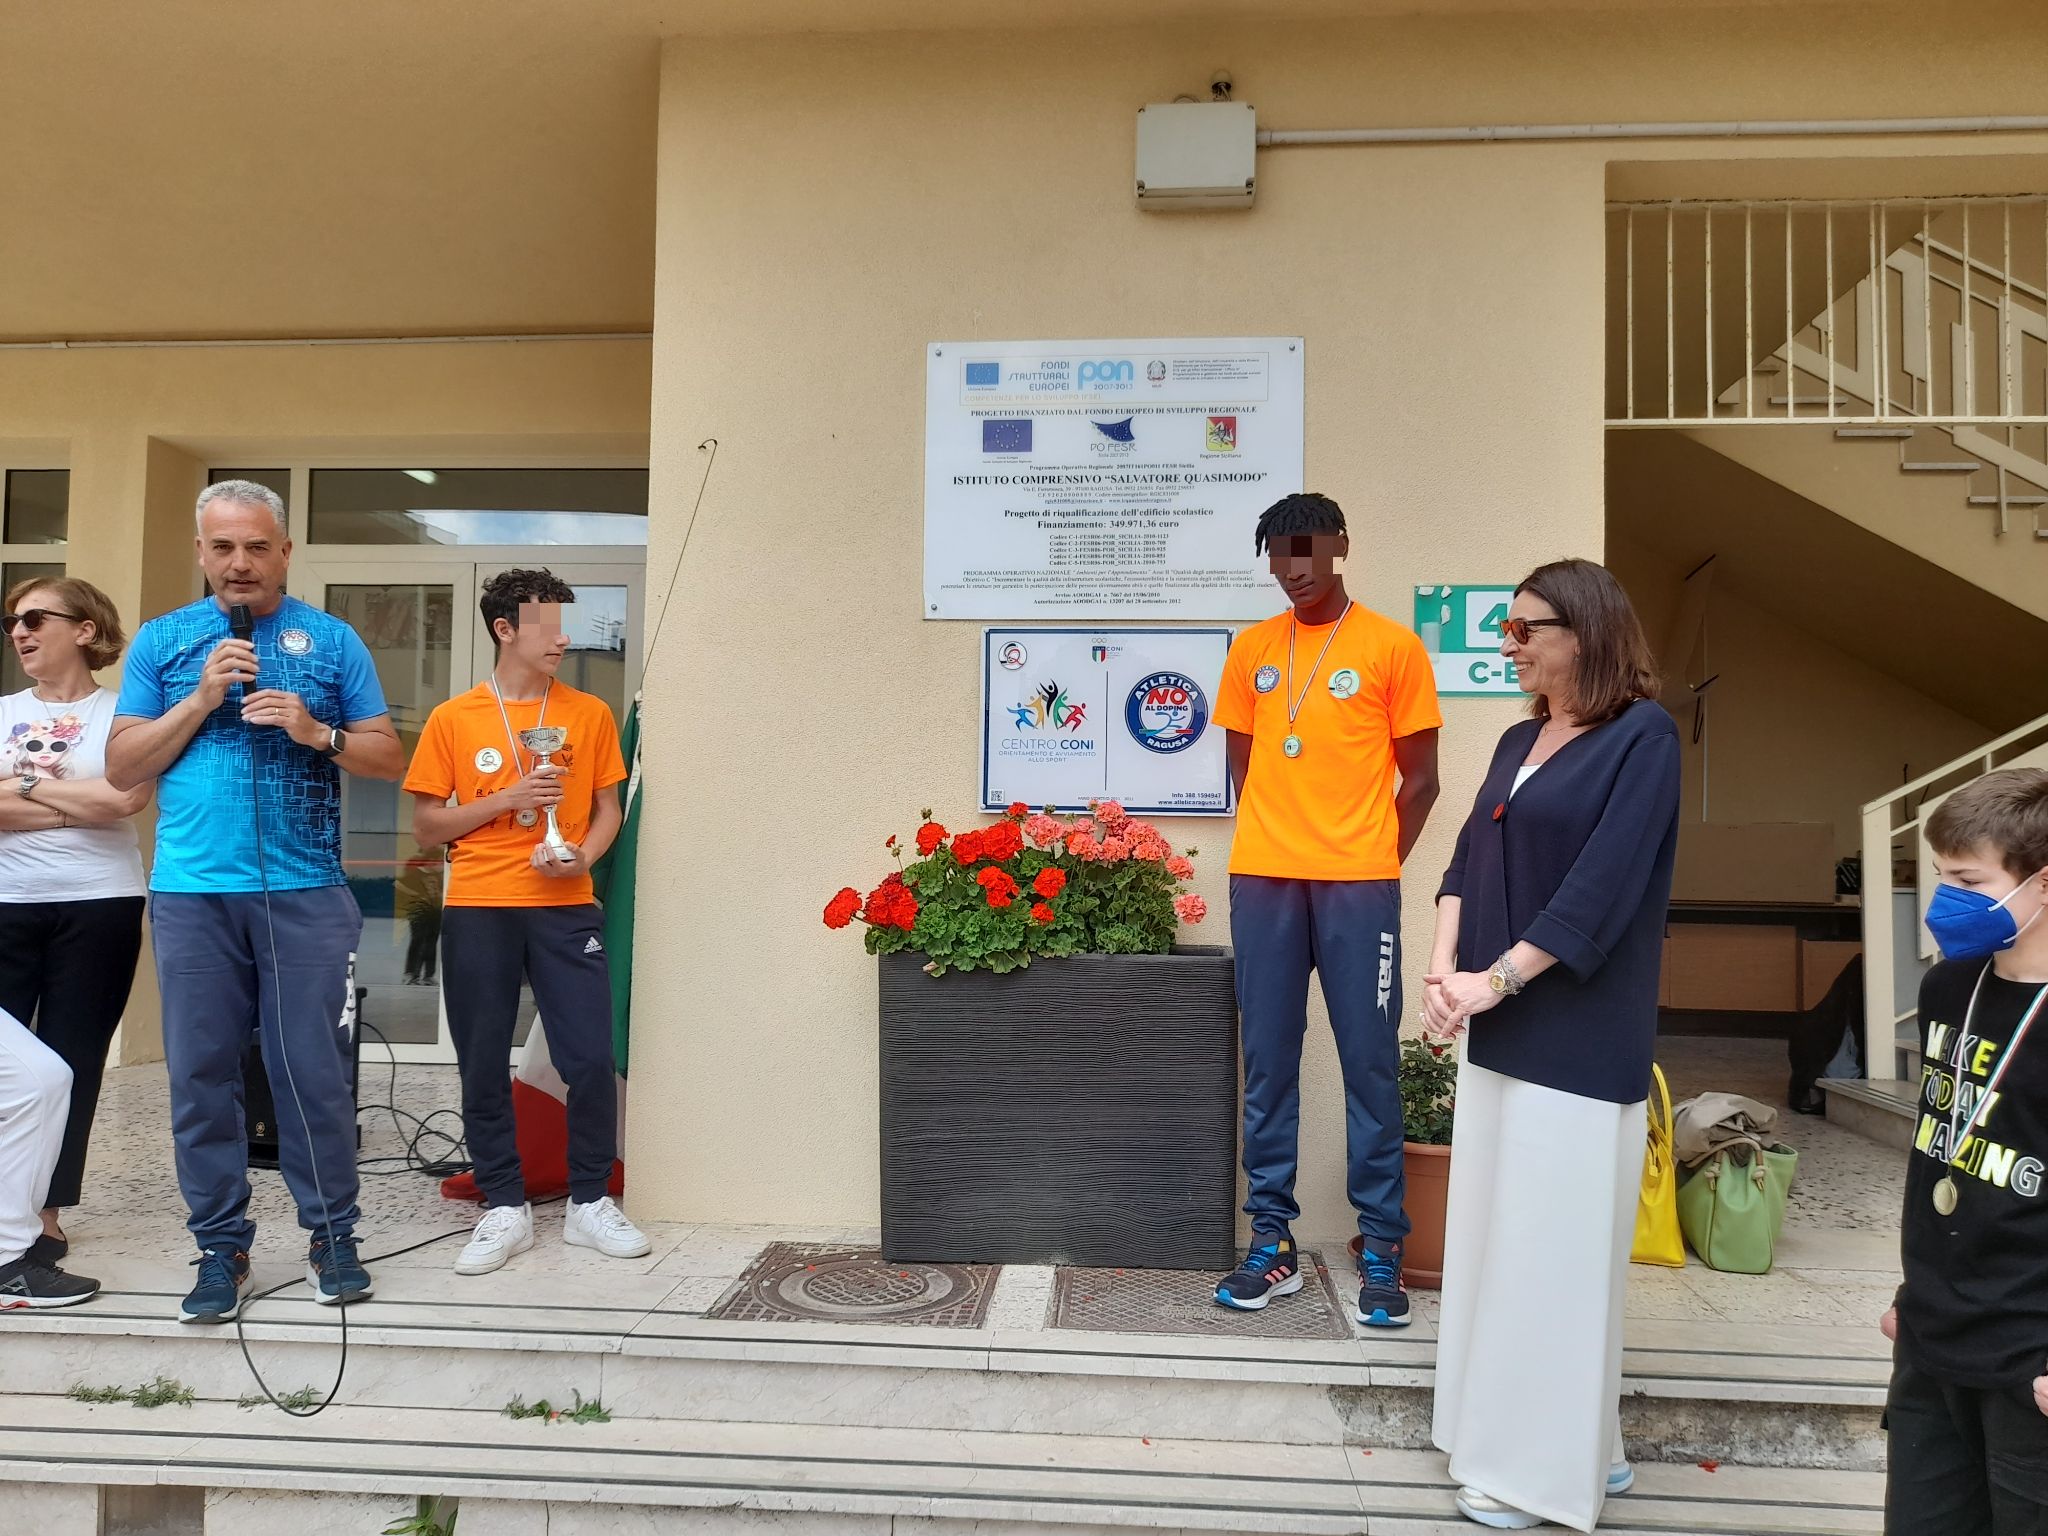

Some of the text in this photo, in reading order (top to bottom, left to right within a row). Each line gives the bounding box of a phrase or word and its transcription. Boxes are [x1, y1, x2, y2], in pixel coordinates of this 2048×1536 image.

[1041, 361, 1070, 369] FONDI
[1008, 371, 1070, 381] STRUTTURALI
[1077, 360, 1134, 391] pon
[1029, 383, 1070, 391] EUROPEI
[971, 405, 1257, 418] PROGETTO FINANZIATO DAL FONDO EUROPEO DI SVILUPPO REGIONALE
[1107, 442, 1137, 452] FESR
[953, 475, 1009, 485] ISTITUTO
[1012, 474, 1101, 485] COMPRENSIVO
[1004, 508, 1214, 518] Progetto di riqualificazione dell'edificio scolastico
[1037, 520, 1107, 529] Finanziamento:
[1109, 519, 1156, 529] 349.971,36
[1478, 603, 1508, 639] 4
[1134, 675, 1199, 701] ATLETICA
[1146, 688, 1188, 705] NO
[1001, 738, 1094, 750] CENTRO CONI
[1146, 736, 1189, 749] RAGUSA
[1925, 1020, 1998, 1077] MAKE
[1919, 1064, 2001, 1128] TODAY
